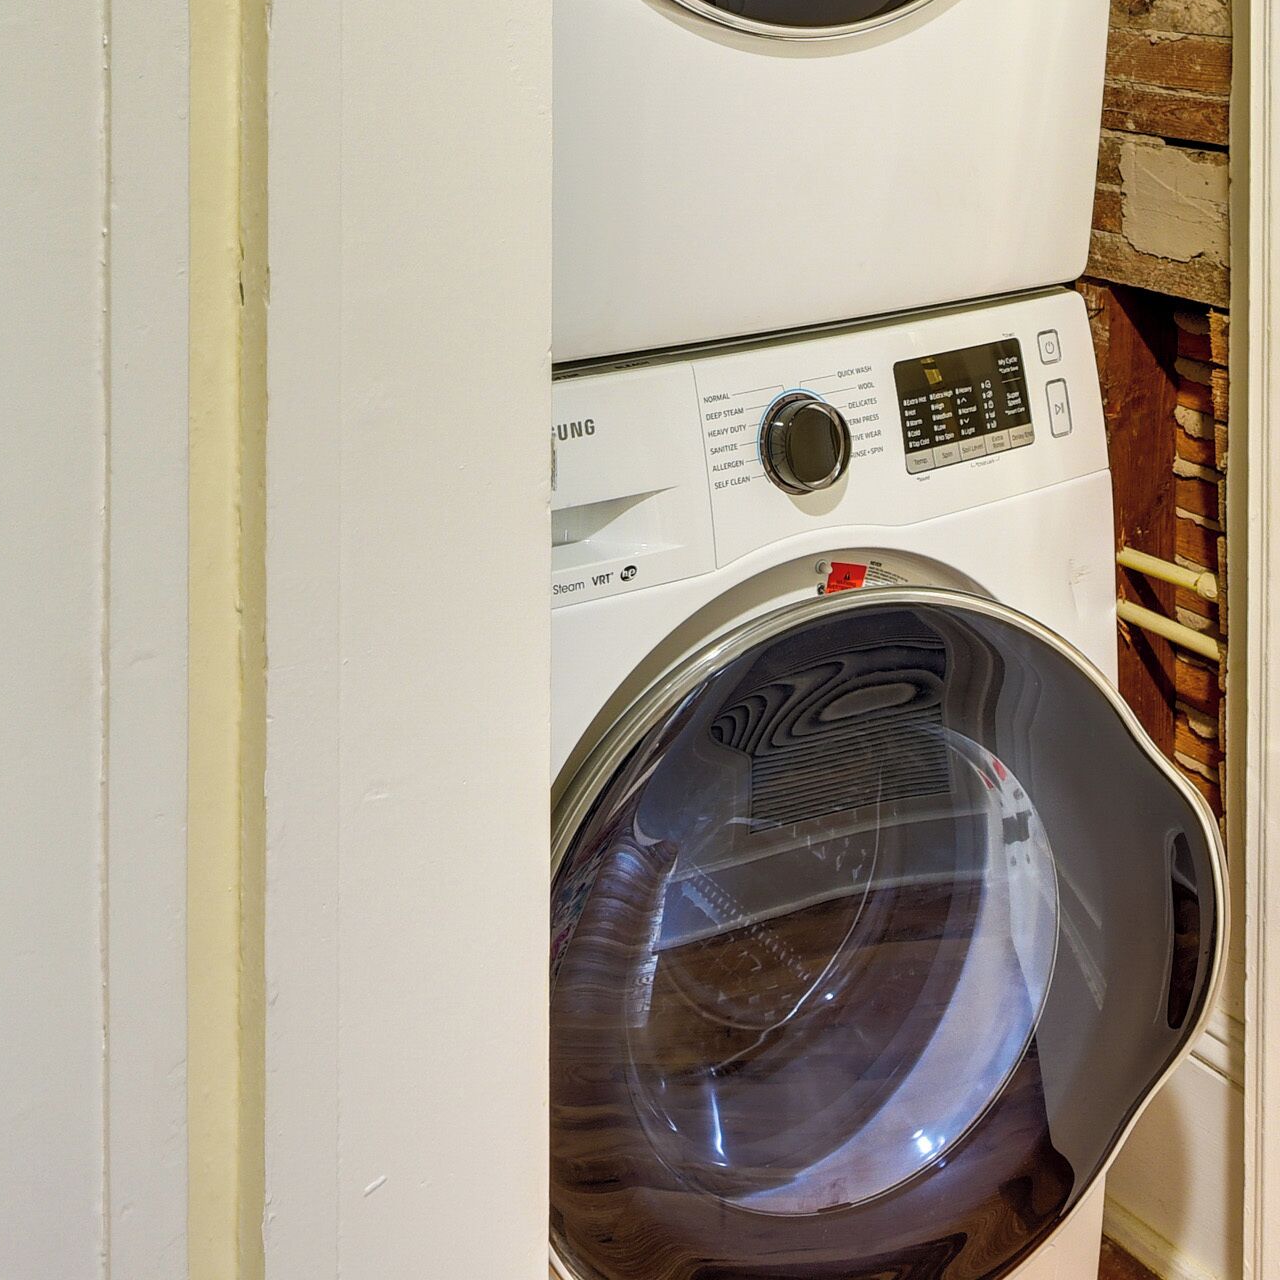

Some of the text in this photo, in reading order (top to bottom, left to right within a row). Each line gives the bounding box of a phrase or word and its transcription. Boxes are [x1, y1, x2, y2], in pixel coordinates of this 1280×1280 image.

[837, 365, 872, 378] QUICK WASH
[858, 382, 875, 390] WOOL
[958, 386, 972, 394] Heavy
[703, 393, 730, 403] NORMAL
[933, 390, 953, 400] Extra High
[1007, 391, 1020, 400] Super
[848, 397, 877, 409] DELICATES
[906, 398, 918, 406] Extra
[1008, 398, 1021, 406] Speed
[706, 408, 744, 421] DEEP STEAM
[961, 406, 977, 414] Normal
[862, 414, 879, 422] PRESS
[936, 412, 953, 420] Medium
[552, 419, 595, 441] UNG
[708, 424, 747, 438] HEAVY DUTY
[865, 430, 882, 439] WEAR
[964, 427, 975, 435] Light
[944, 432, 954, 440] Spin
[710, 443, 738, 455] SANITIZE
[712, 460, 744, 472] ALLERGEN
[714, 475, 750, 490] SELF CLEAN
[553, 581, 585, 595] Steam
